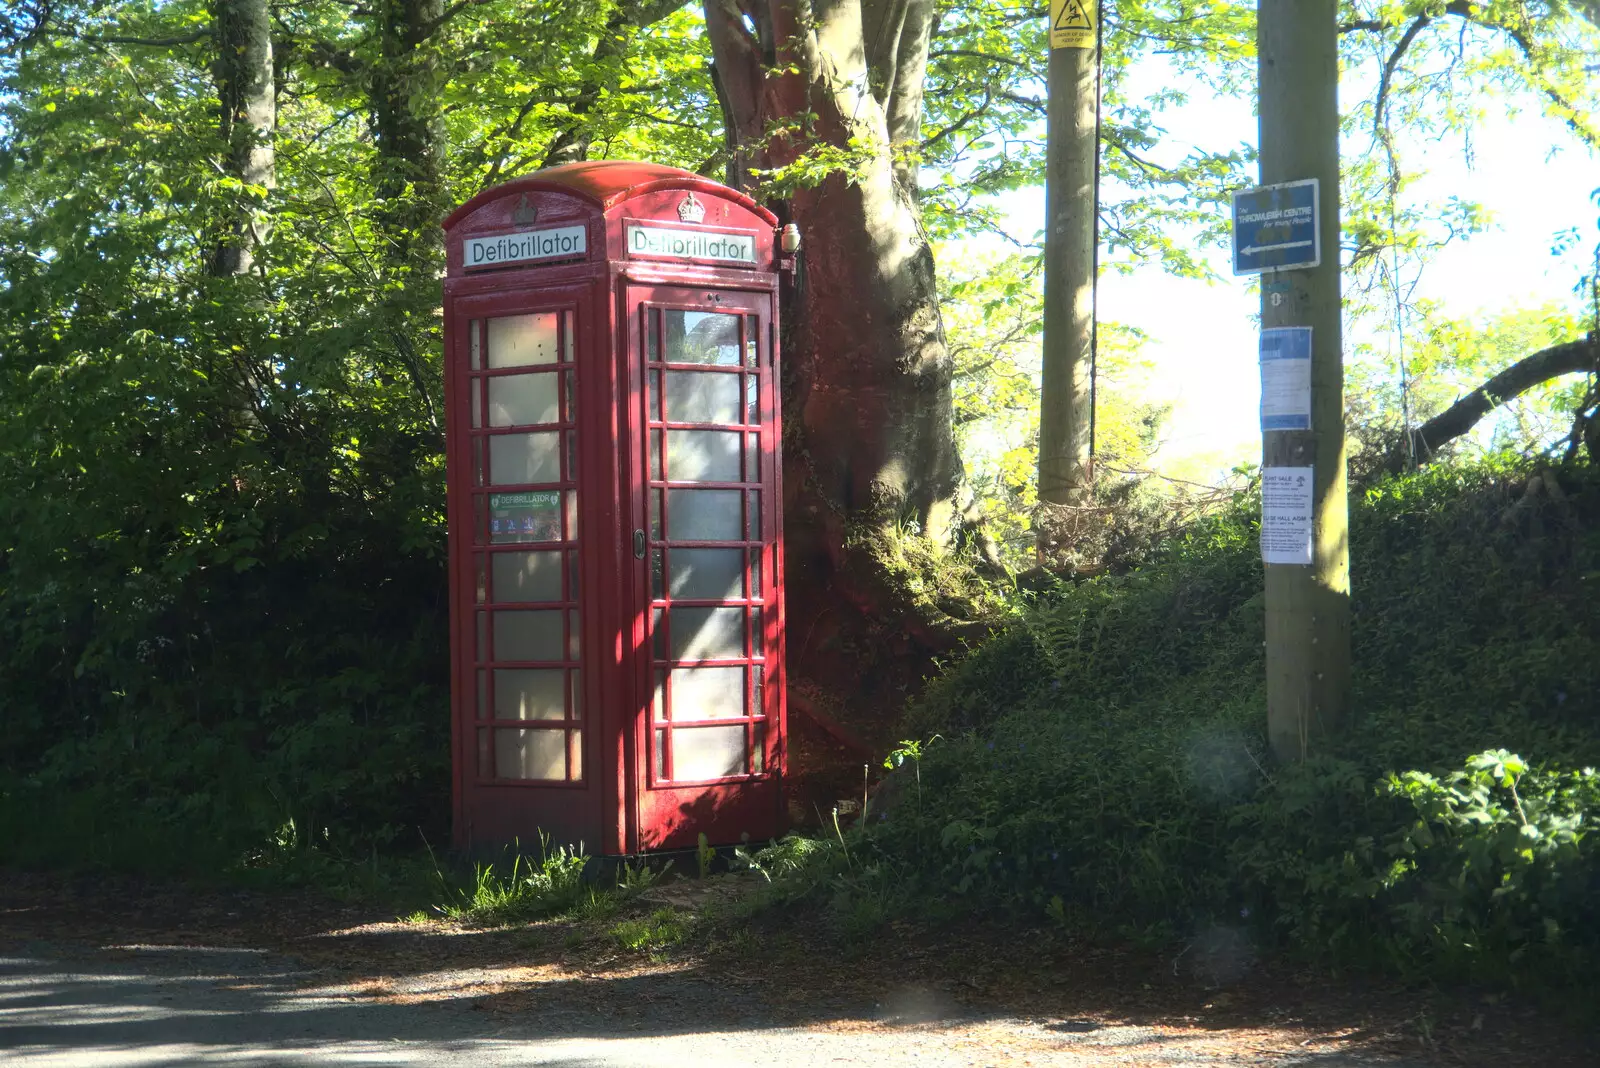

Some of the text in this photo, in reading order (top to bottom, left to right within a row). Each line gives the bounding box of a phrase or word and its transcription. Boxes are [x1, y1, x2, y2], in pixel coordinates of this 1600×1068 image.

[1238, 206, 1312, 224] THROWLEIGH CENTRE
[473, 234, 580, 263] Defibrillator
[634, 229, 748, 260] Defibrillator
[501, 494, 550, 504] DEFIBRILLATOR
